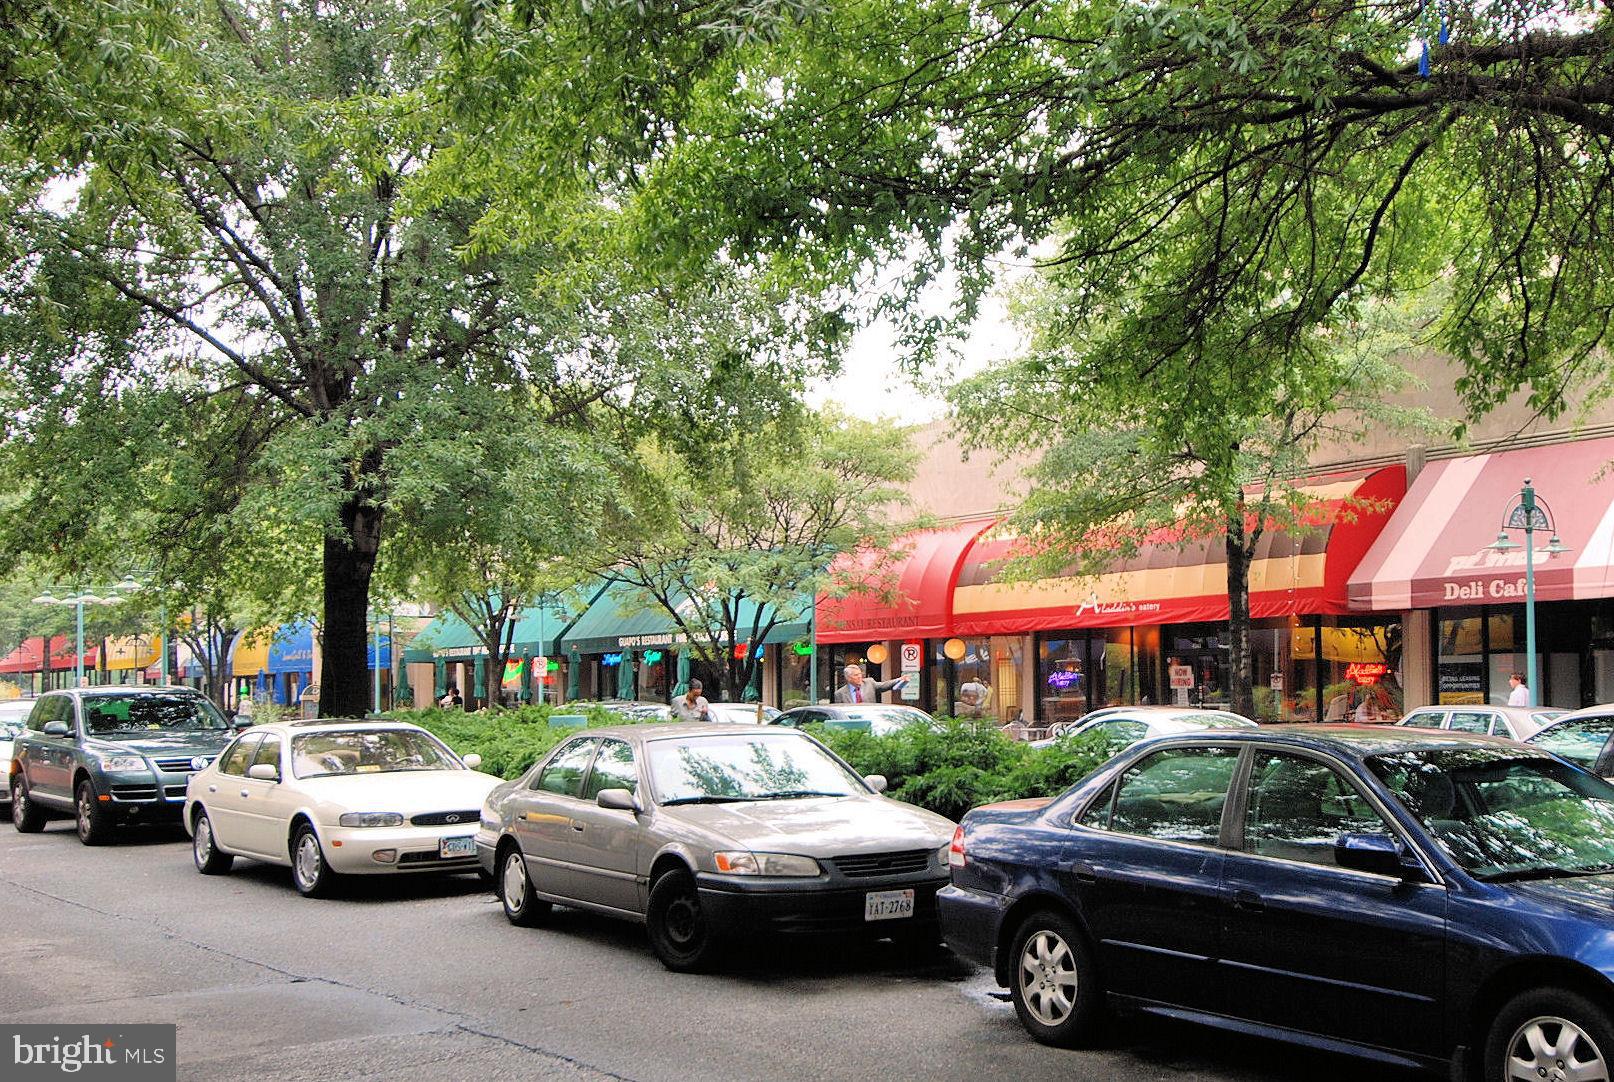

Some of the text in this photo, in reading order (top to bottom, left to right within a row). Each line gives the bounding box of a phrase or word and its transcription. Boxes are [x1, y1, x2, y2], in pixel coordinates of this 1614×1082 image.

[1443, 581, 1484, 600] Deli
[1076, 593, 1160, 616] Aladdin's eatery
[866, 616, 919, 628] RESTAURANT
[641, 634, 673, 645] RESTAURANT
[1174, 668, 1188, 676] NOW
[869, 900, 911, 915] YAT-2768
